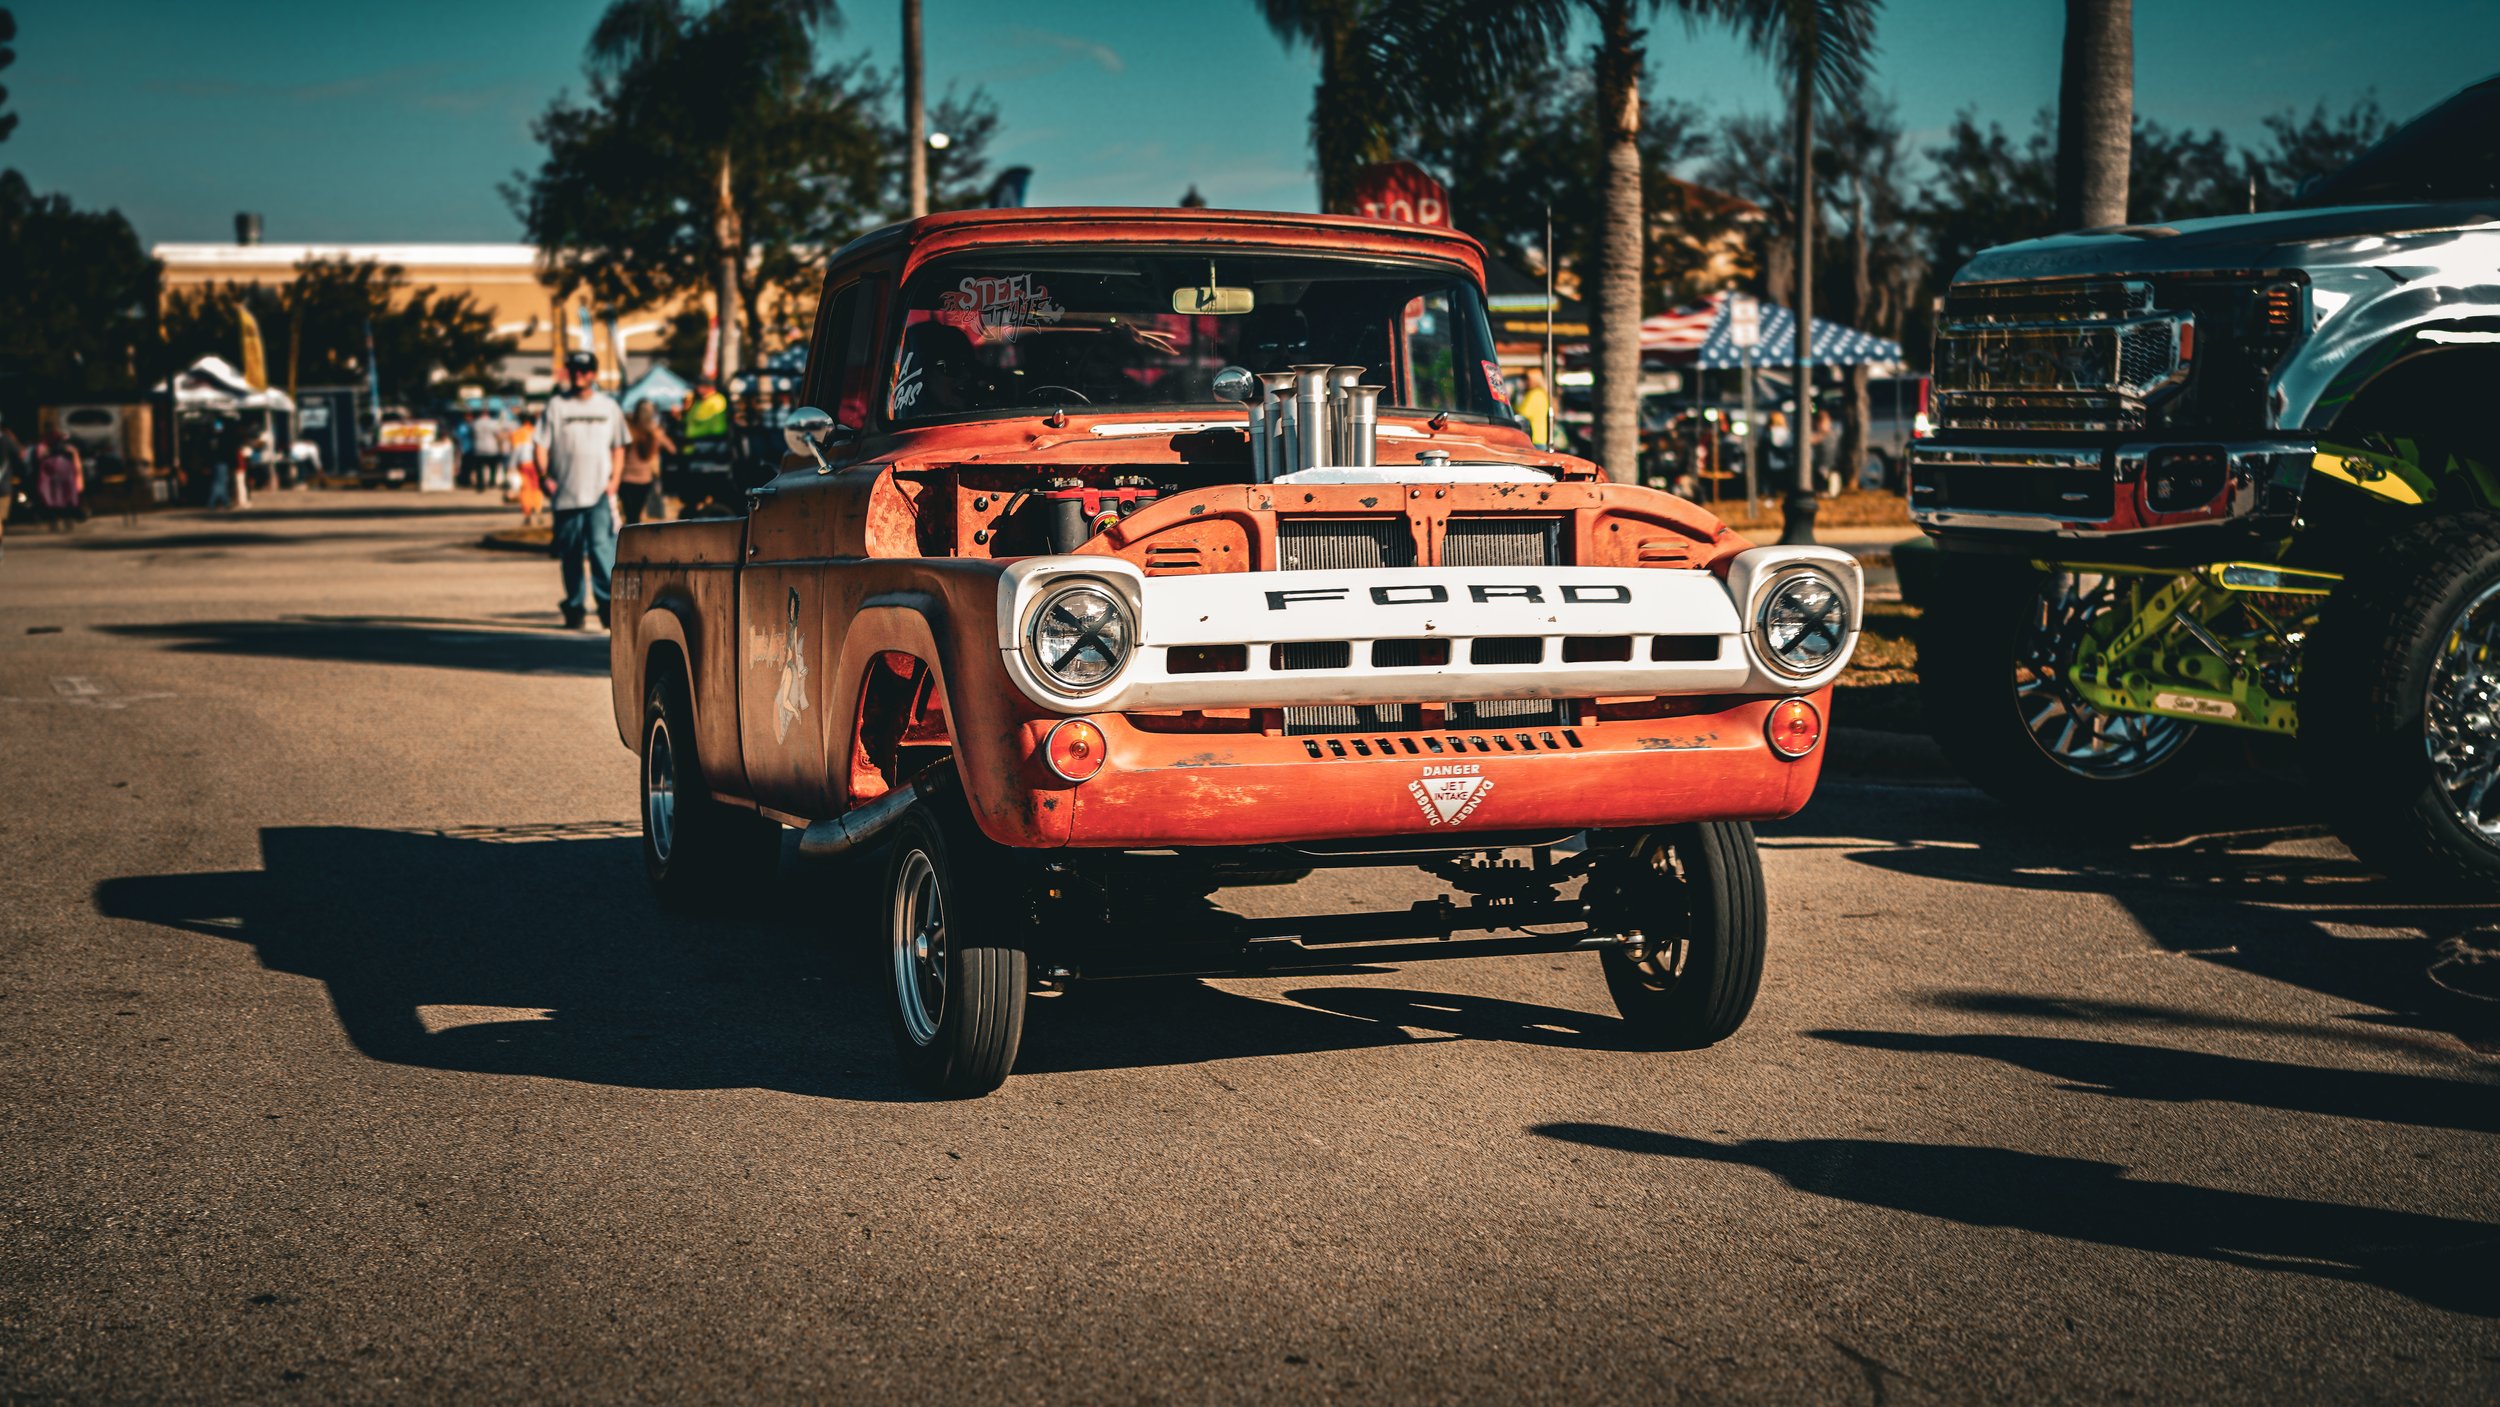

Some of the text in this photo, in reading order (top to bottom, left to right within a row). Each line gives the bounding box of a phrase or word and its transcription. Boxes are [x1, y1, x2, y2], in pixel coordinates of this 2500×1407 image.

[958, 273, 1042, 310] STEEL
[894, 381, 923, 410] GAS
[1265, 584, 1632, 611] FORD
[1423, 764, 1480, 777] DANGER
[1434, 791, 1469, 801] INTAKE
[1440, 781, 1467, 791] JET
[1408, 780, 1441, 826] DANGER
[1450, 780, 1495, 826] DANGER
